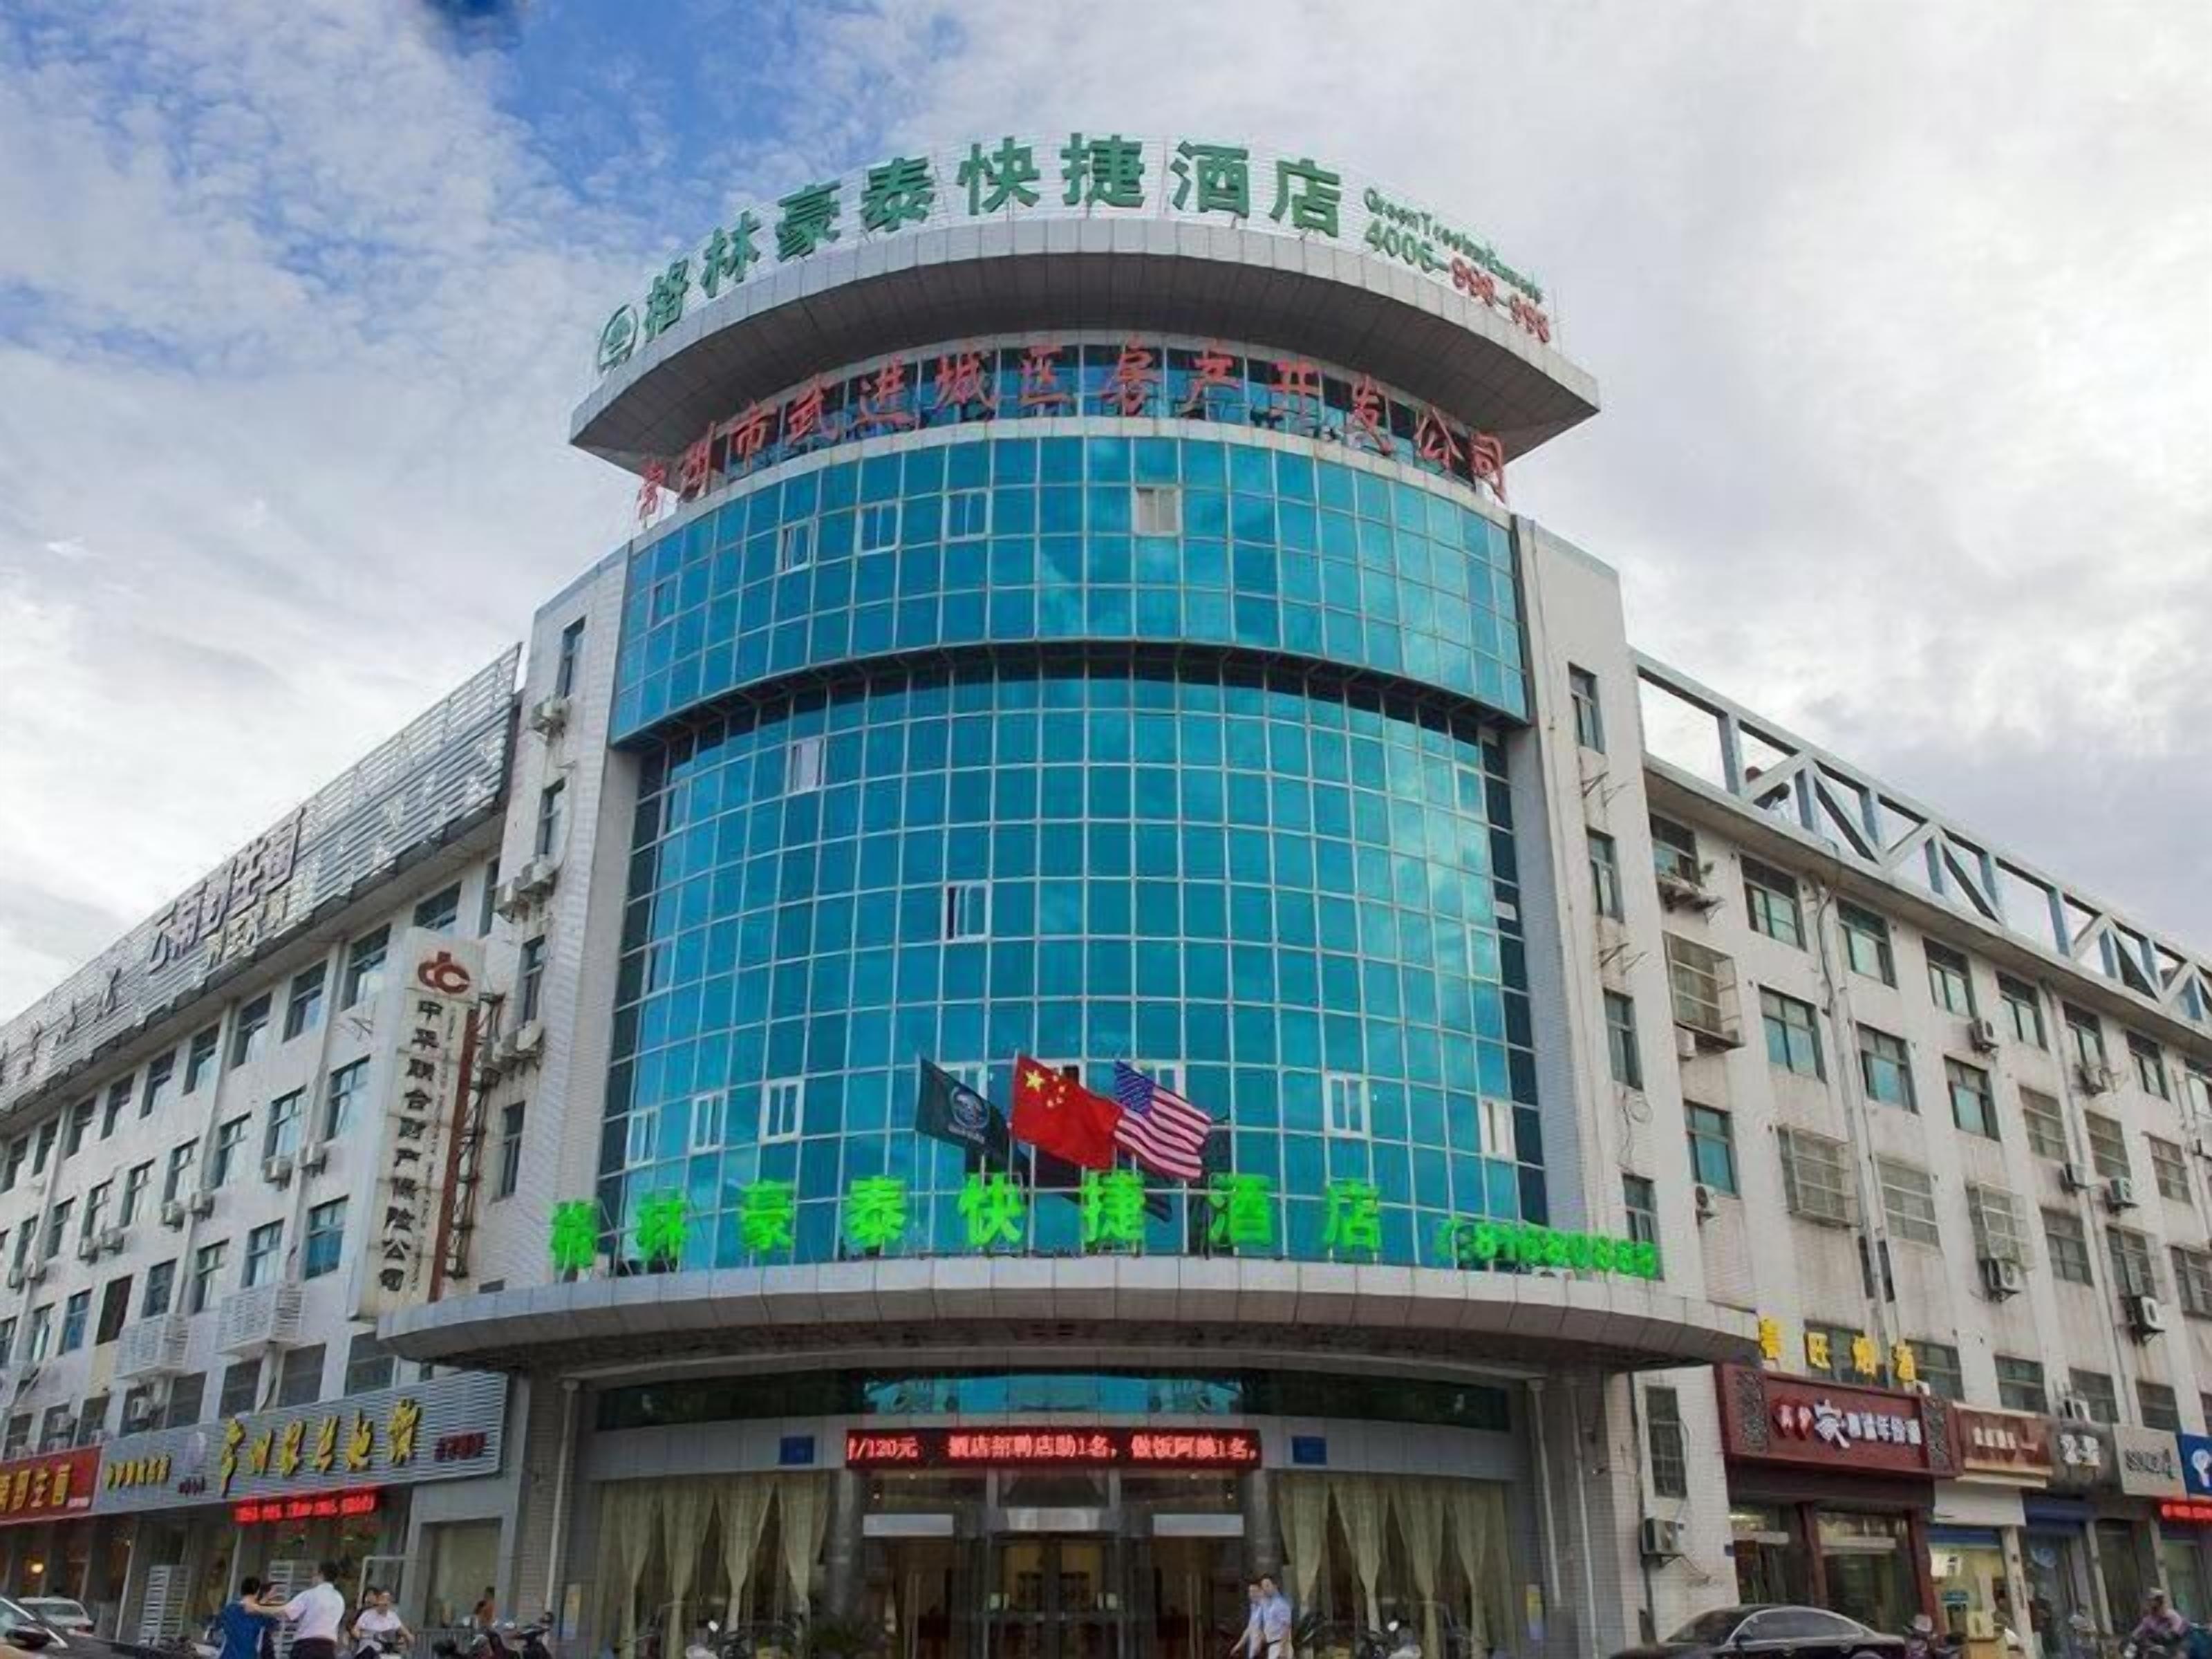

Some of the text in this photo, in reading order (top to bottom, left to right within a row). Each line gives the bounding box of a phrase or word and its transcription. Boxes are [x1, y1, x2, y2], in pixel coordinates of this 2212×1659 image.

[644, 133, 1341, 341] 格林豪泰快捷酒店
[379, 1000, 442, 1292] 中华联合财产保险公司
[552, 1172, 1380, 1271] 格林豪泰快捷酒店
